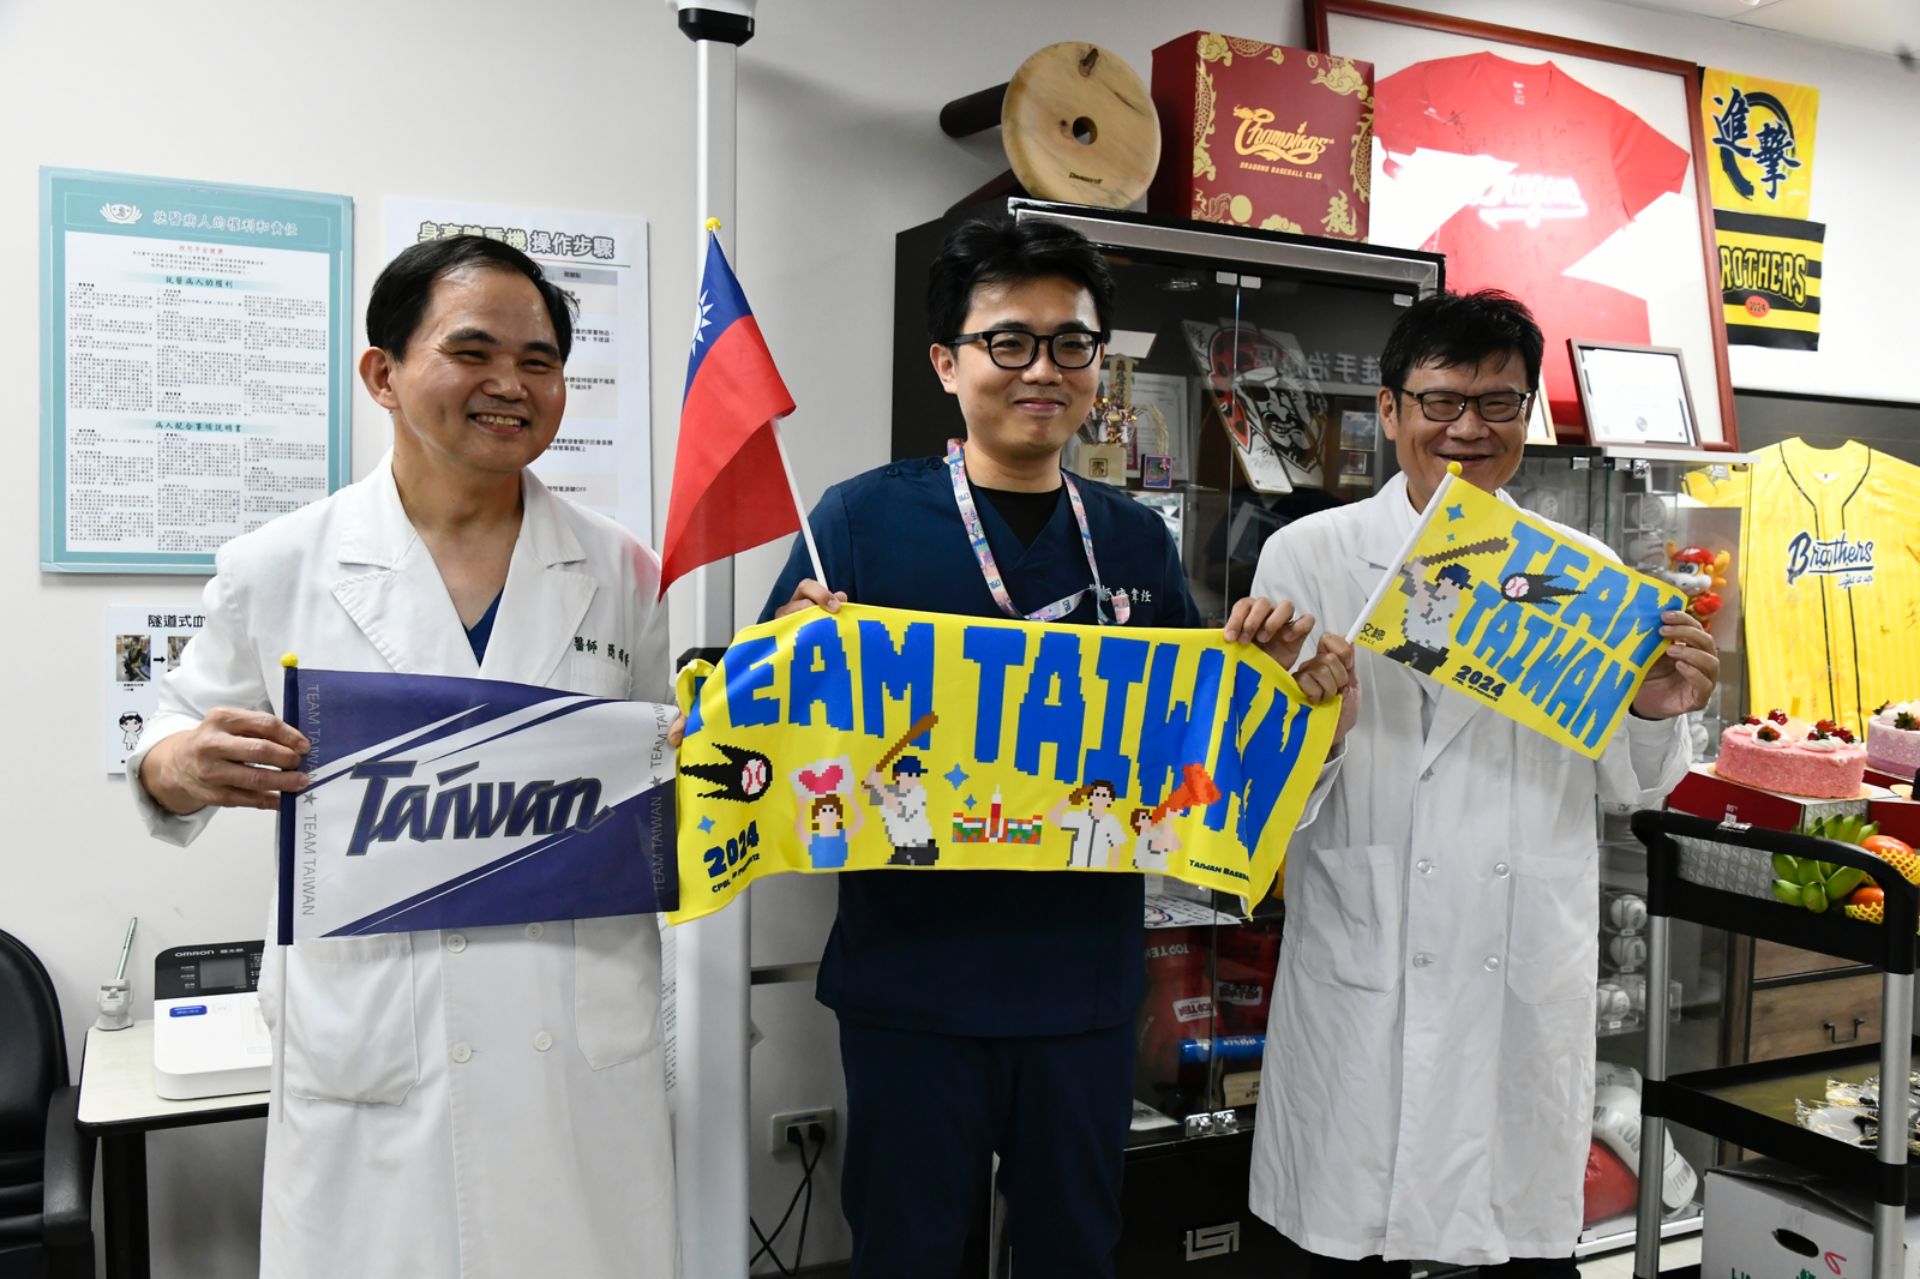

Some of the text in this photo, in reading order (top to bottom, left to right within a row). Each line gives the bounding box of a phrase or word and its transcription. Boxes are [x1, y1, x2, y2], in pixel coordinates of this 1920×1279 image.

[1270, 166, 1303, 178] BASEBALL
[1713, 86, 1801, 199] 進擊
[1320, 189, 1357, 236] 龍
[530, 229, 615, 260] 操作步驟
[1720, 245, 1808, 307] ROTHERS
[1786, 531, 1874, 586] Brothers
[1498, 520, 1684, 669] TEAM
[1455, 580, 1636, 750] TAIWAN
[1455, 665, 1507, 698] 2024
[307, 683, 320, 726] TEAM
[650, 734, 668, 769] TEAM
[346, 760, 616, 857] Taiwan
[302, 814, 317, 916] TEAM TAIWAN
[651, 796, 668, 892] TEAM TAIWAN
[704, 820, 760, 879] 2024
